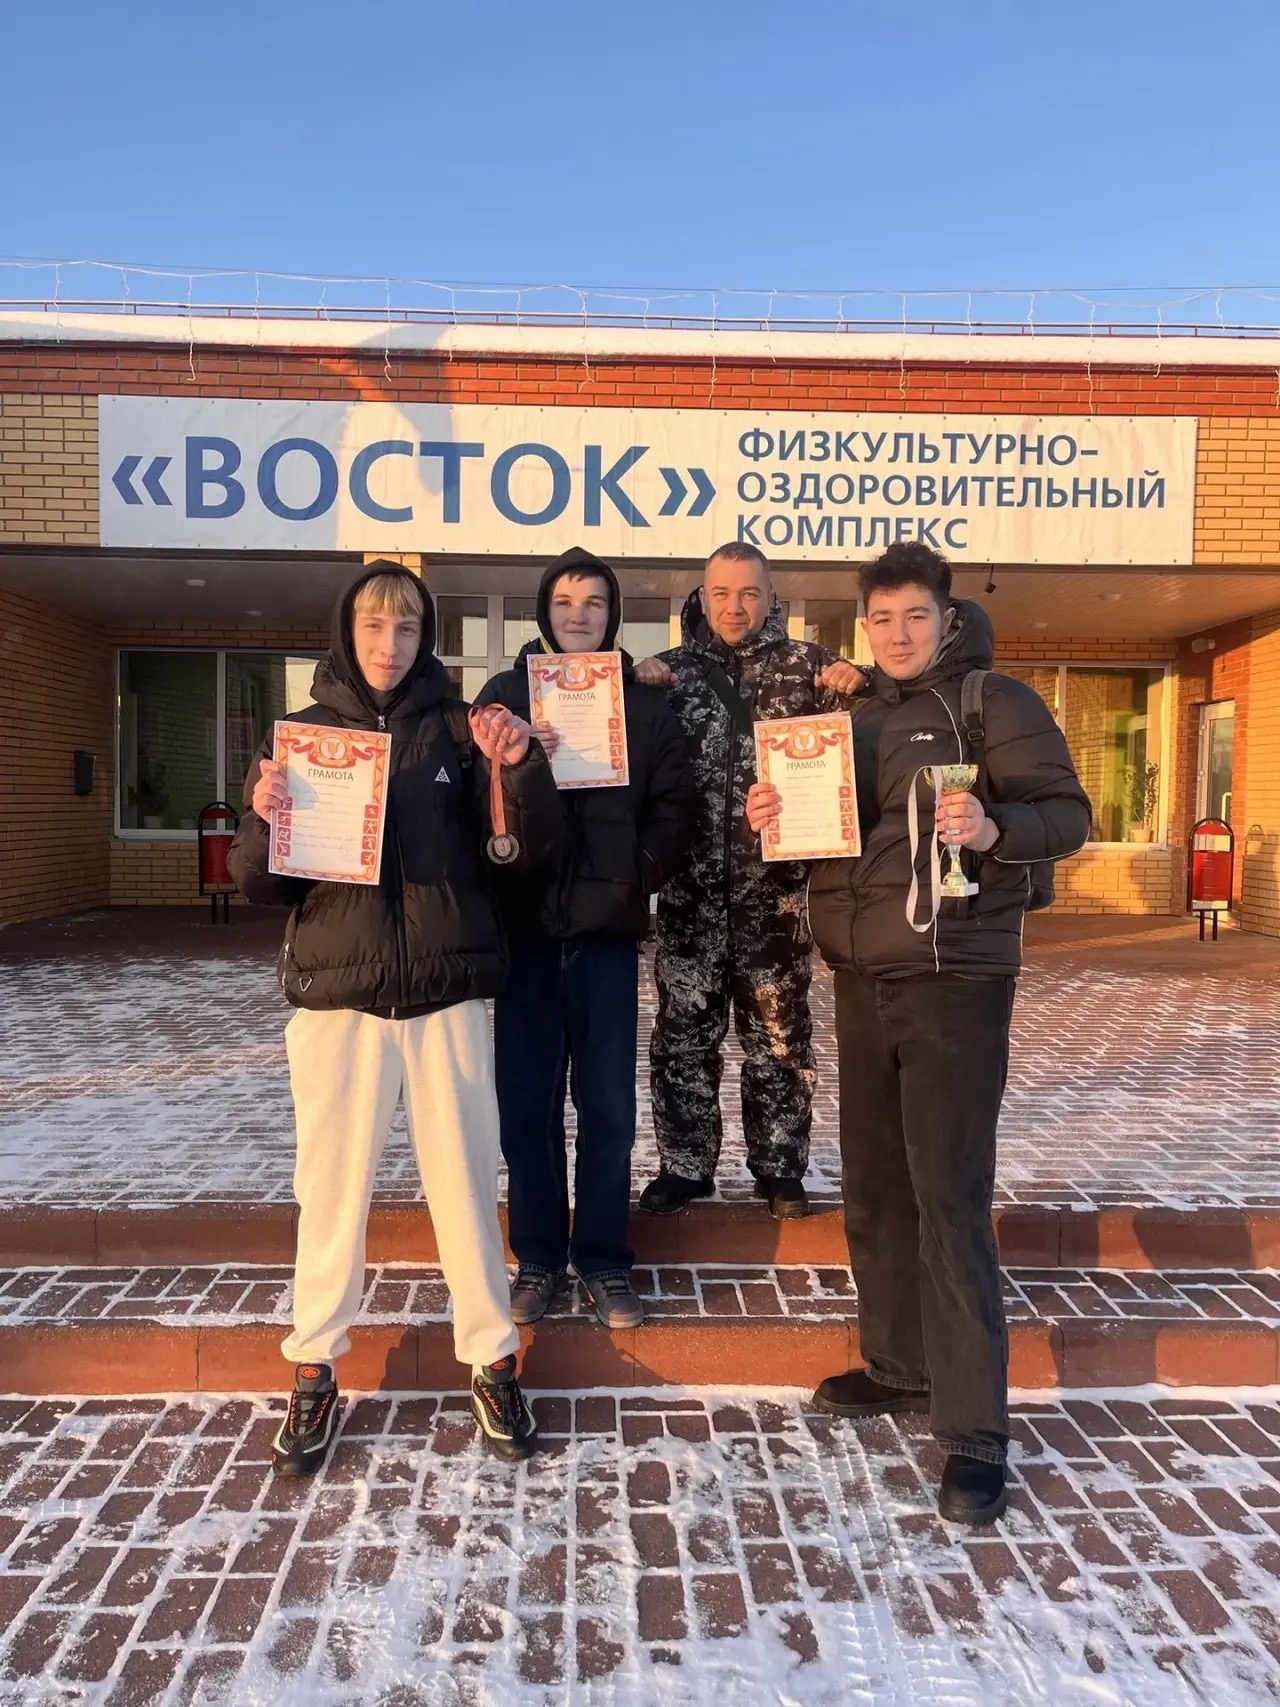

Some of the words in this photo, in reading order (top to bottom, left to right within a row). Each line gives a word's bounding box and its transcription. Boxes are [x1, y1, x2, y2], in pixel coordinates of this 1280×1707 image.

[738, 428, 1098, 466] ФИЗКУЛЬТУРНО-
[112, 436, 716, 527] «ВОСТОК»
[737, 470, 1165, 509] ОЗДОРОВИТЕЛЬНЫЙ
[737, 514, 968, 549] КОМПЛЕКС
[558, 692, 596, 701] ГРАМОТА
[308, 768, 354, 781] ГРАМОТА
[786, 760, 826, 770] ГРАМОТА
